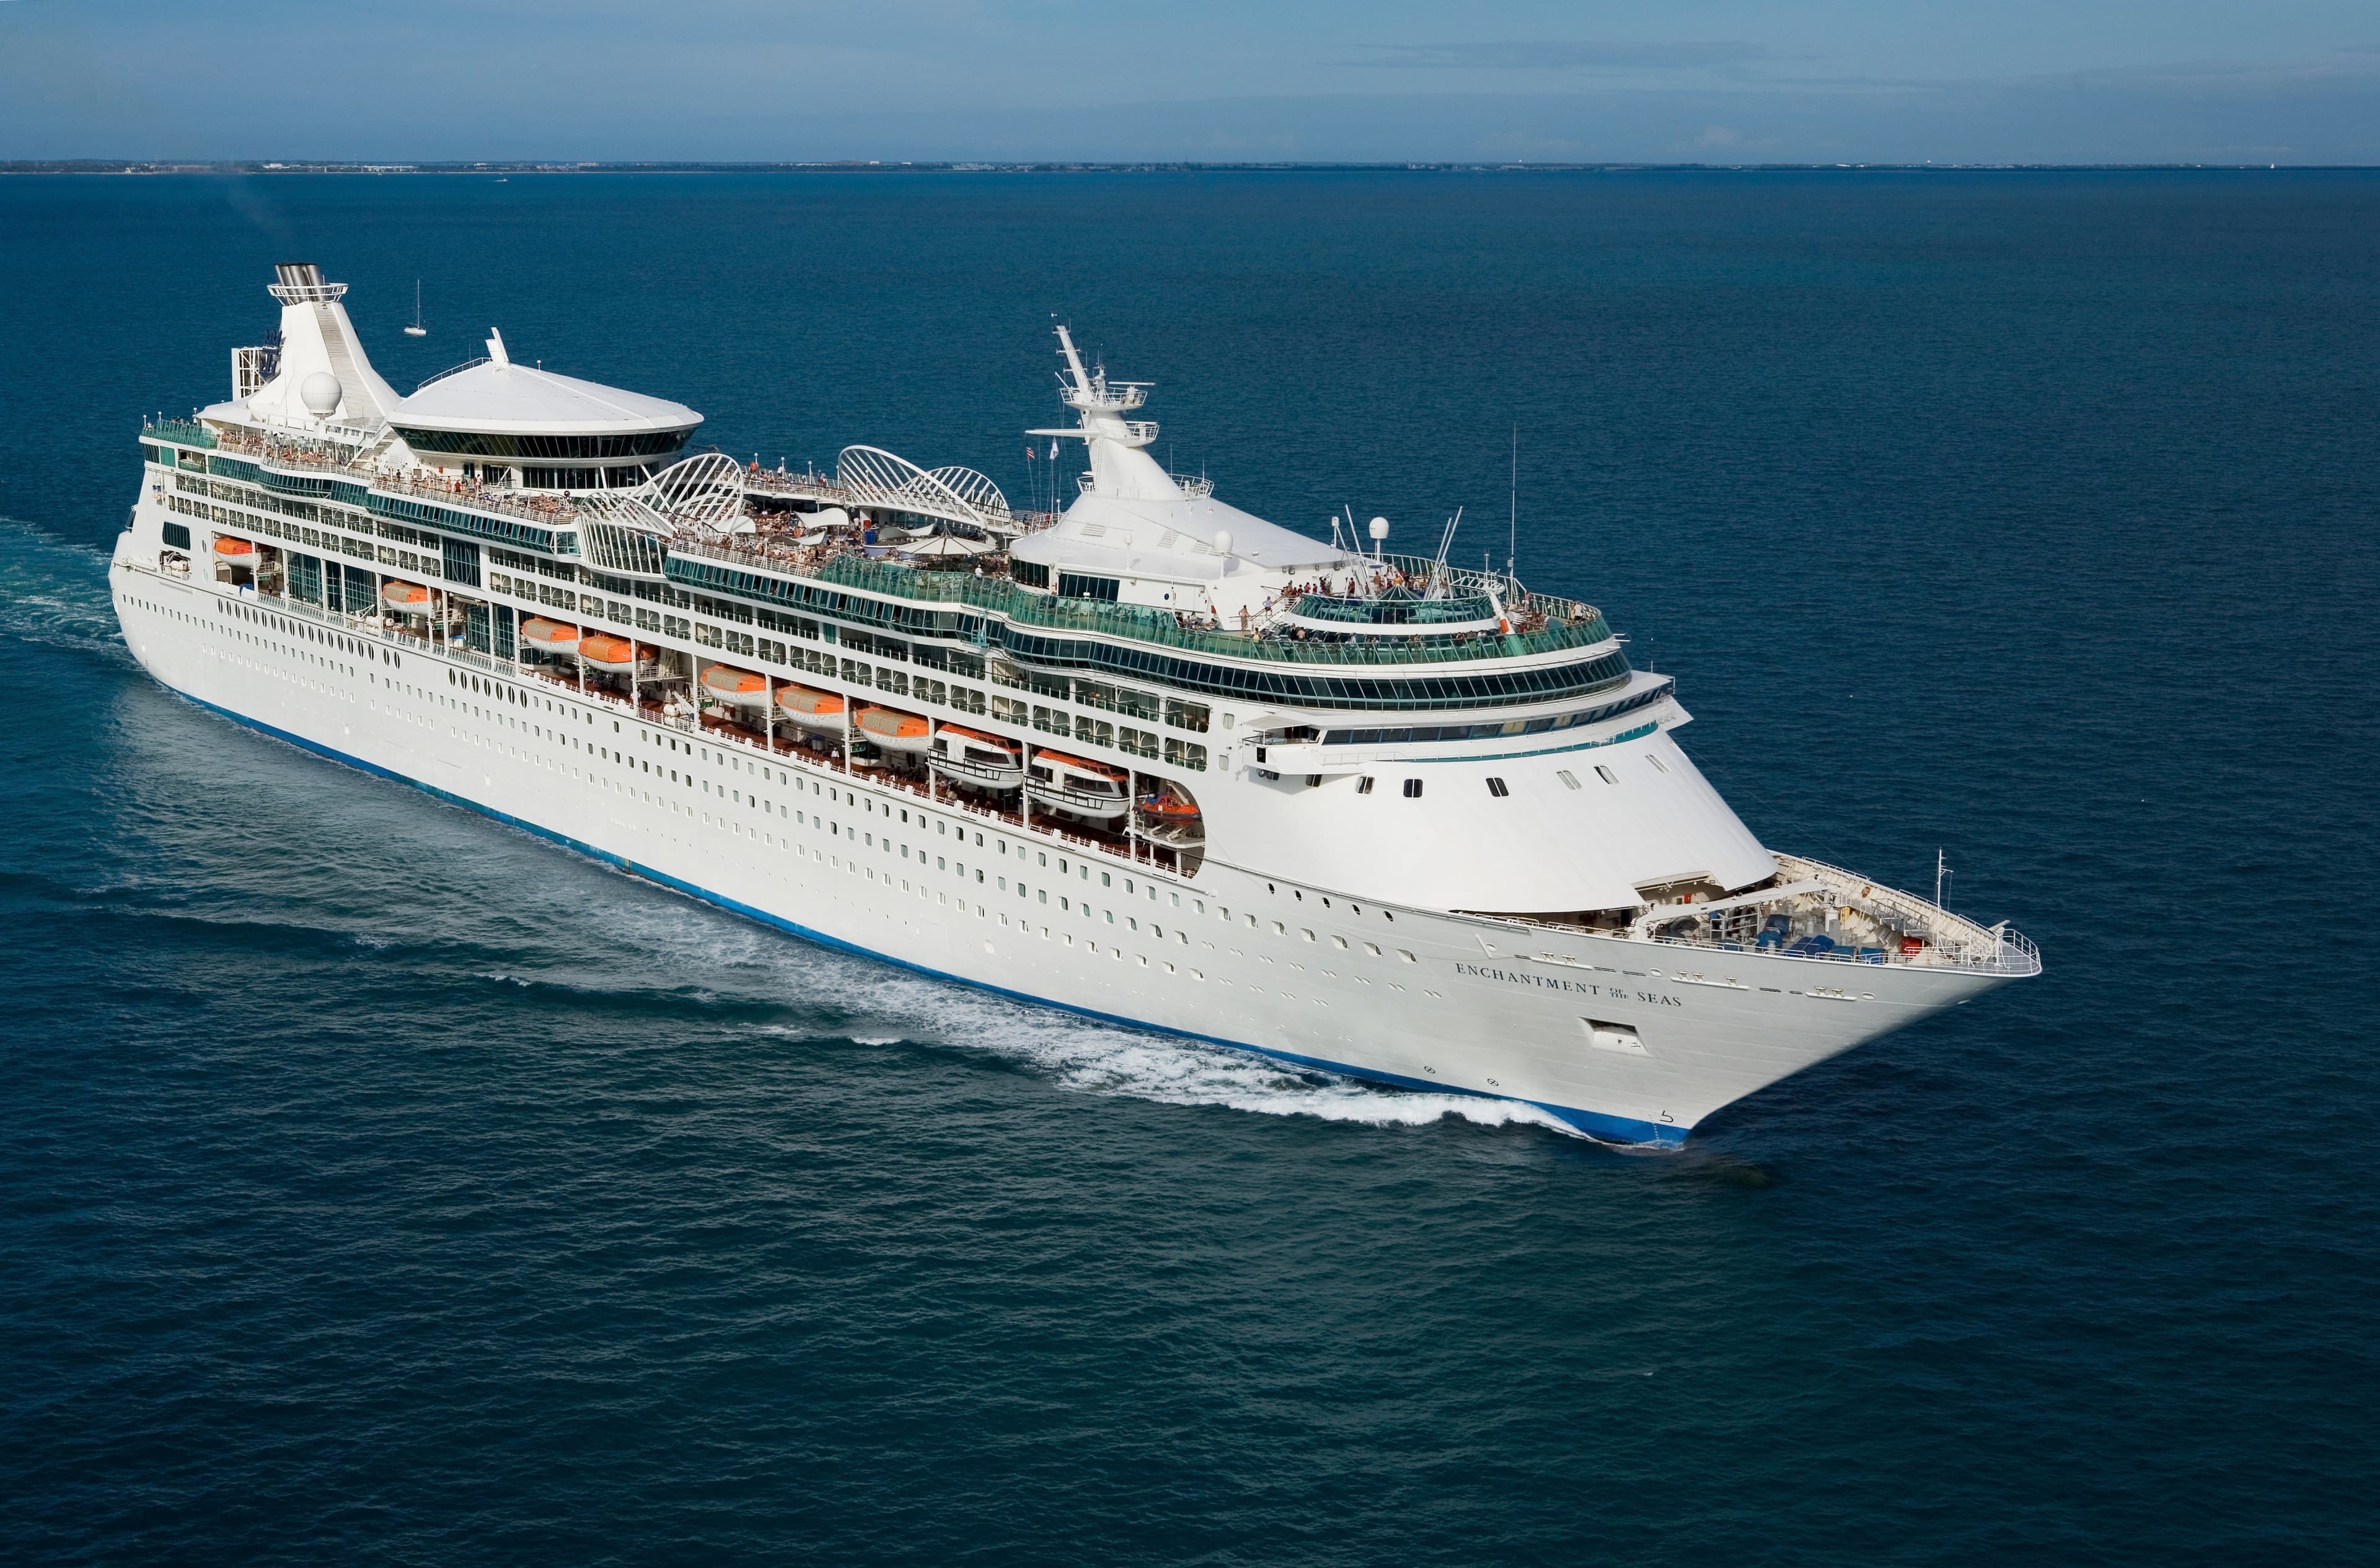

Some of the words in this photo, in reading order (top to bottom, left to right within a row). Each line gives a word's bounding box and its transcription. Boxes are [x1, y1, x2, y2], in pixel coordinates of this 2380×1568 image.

[1455, 962, 1600, 995] ENCHANTMENT
[1610, 992, 1629, 1000] THE
[1637, 992, 1681, 1007] SEAS
